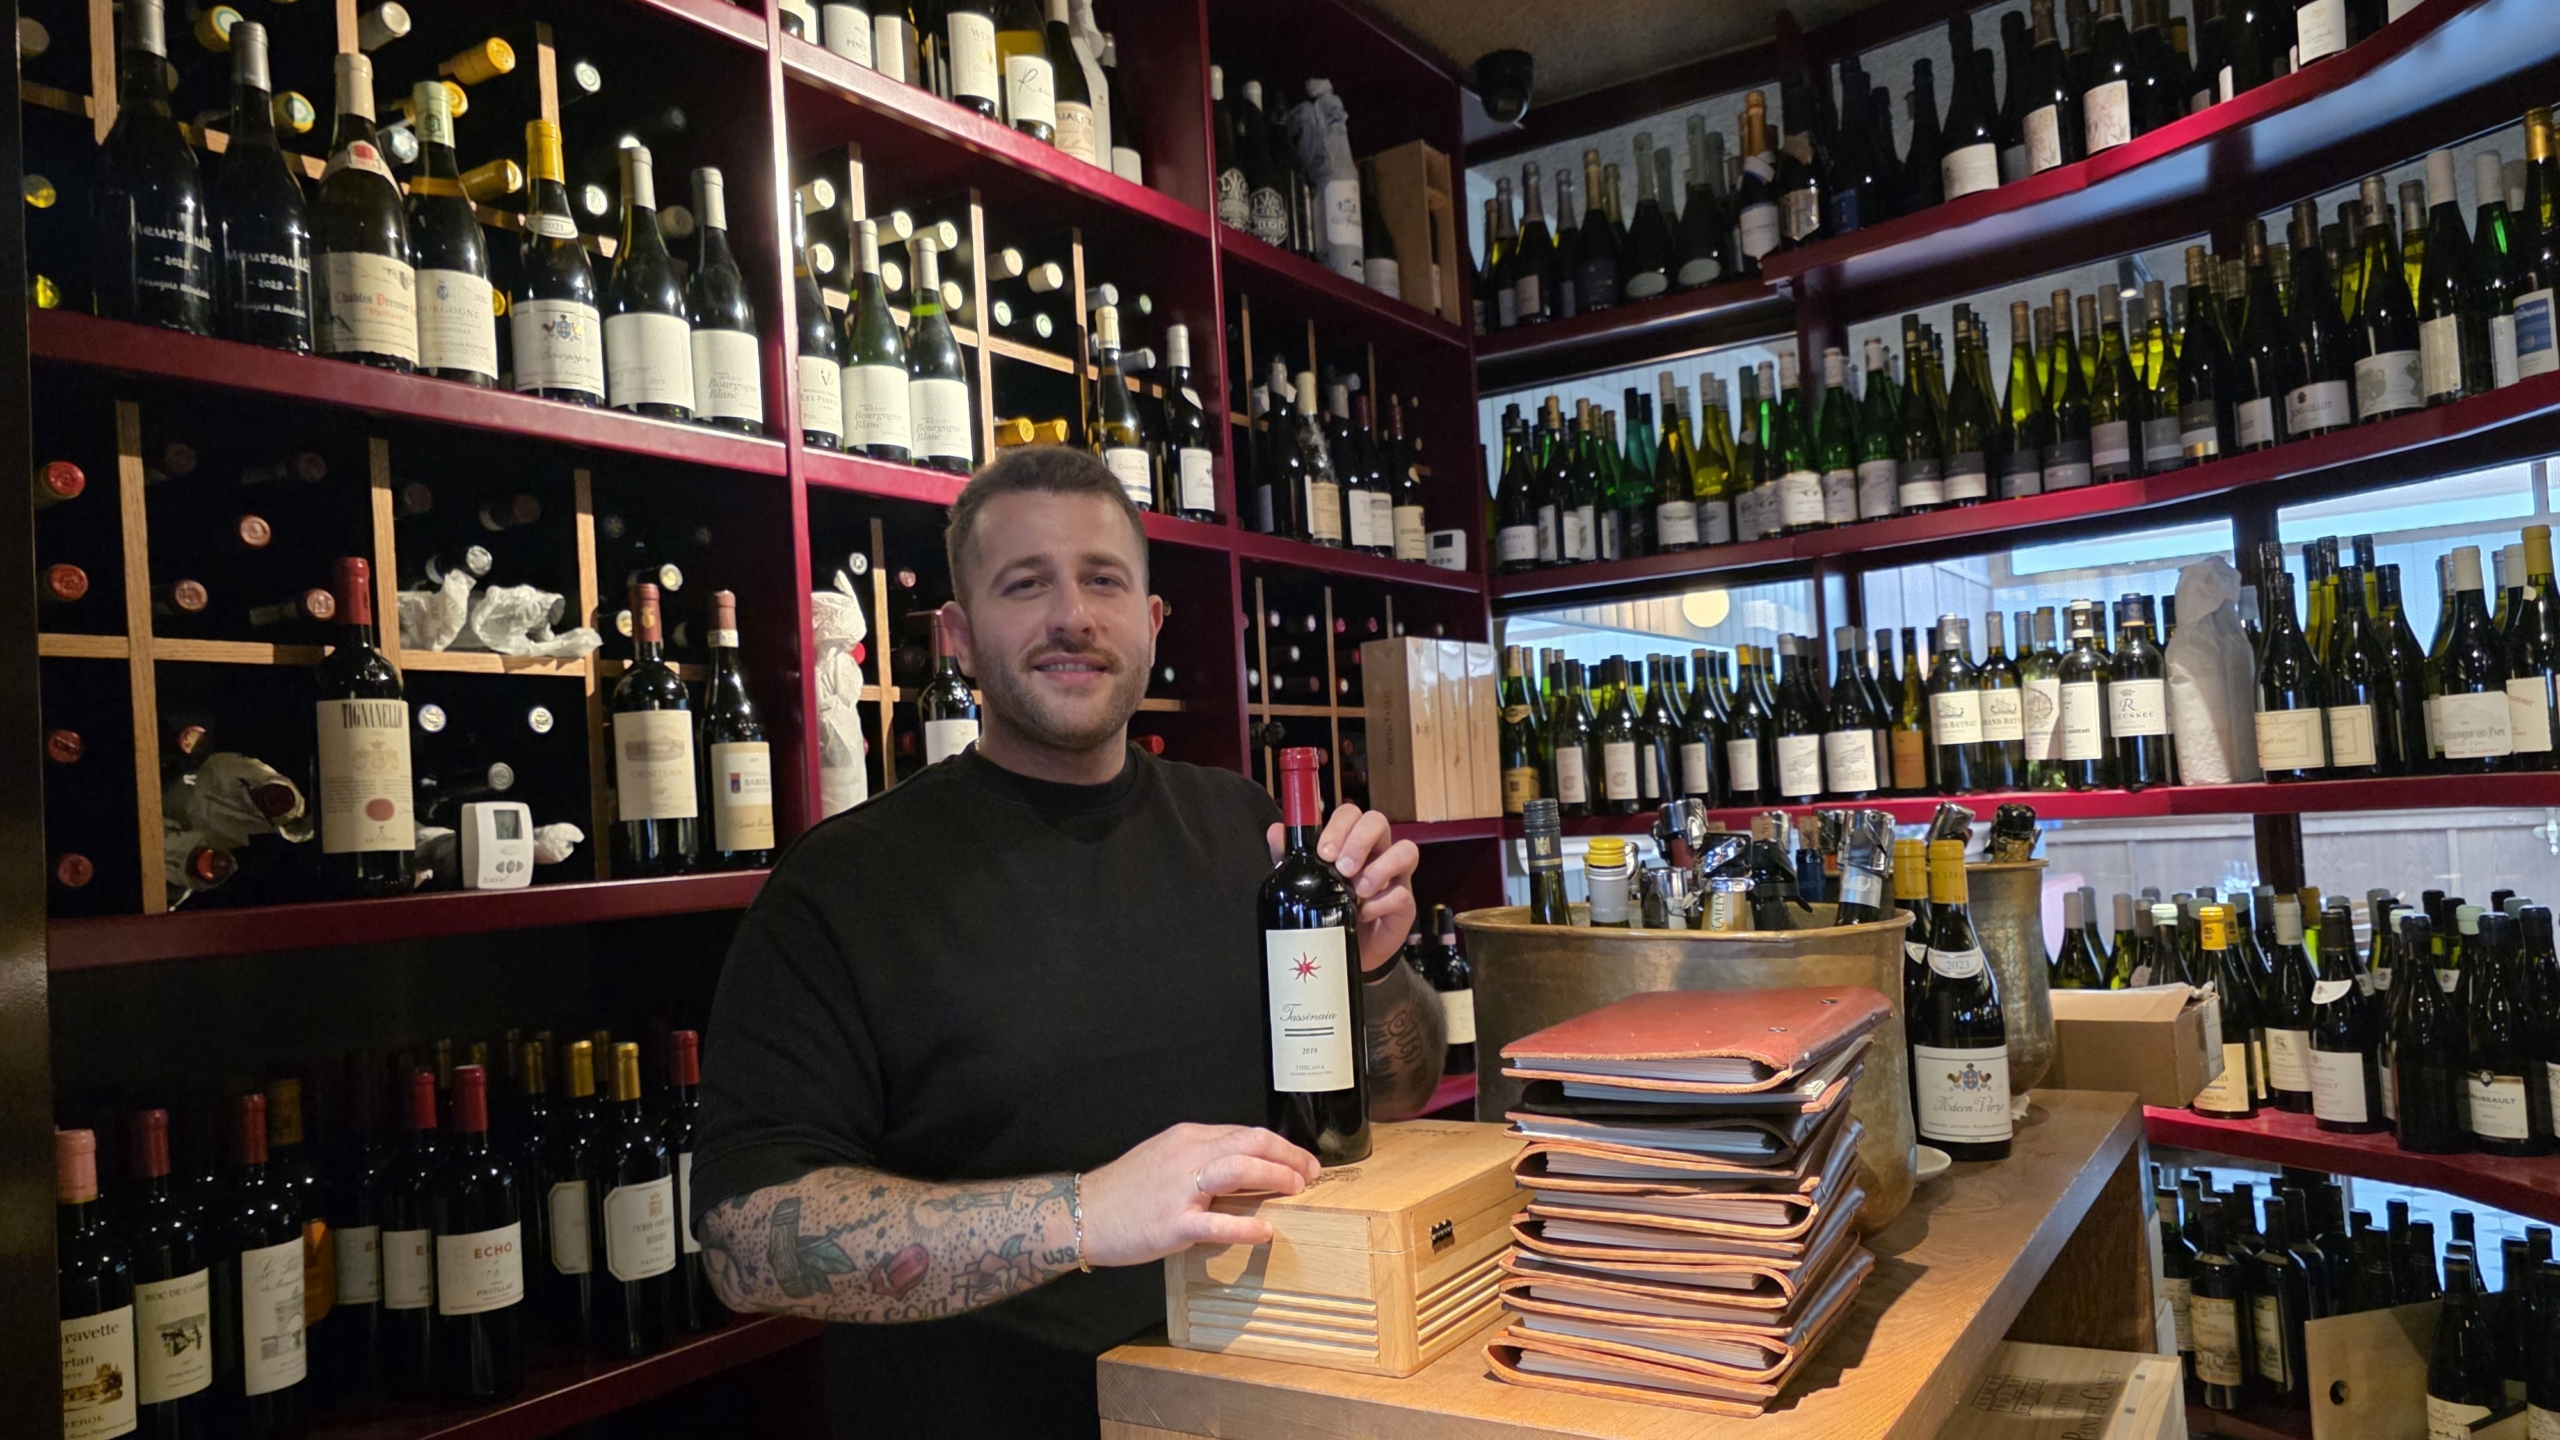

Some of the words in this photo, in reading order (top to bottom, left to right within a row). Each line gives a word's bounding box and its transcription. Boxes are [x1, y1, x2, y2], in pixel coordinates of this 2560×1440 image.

[341, 702, 403, 729] TIGNANELLO
[1946, 959, 1971, 971] 2023
[1279, 1002, 1338, 1022] Tassinaia
[1301, 1047, 1319, 1055] 2019
[474, 1242, 513, 1260] ECHO
[144, 1291, 167, 1302] ROC
[169, 1287, 183, 1298] DE
[61, 1323, 119, 1344] ravette
[61, 1355, 95, 1369] rtan
